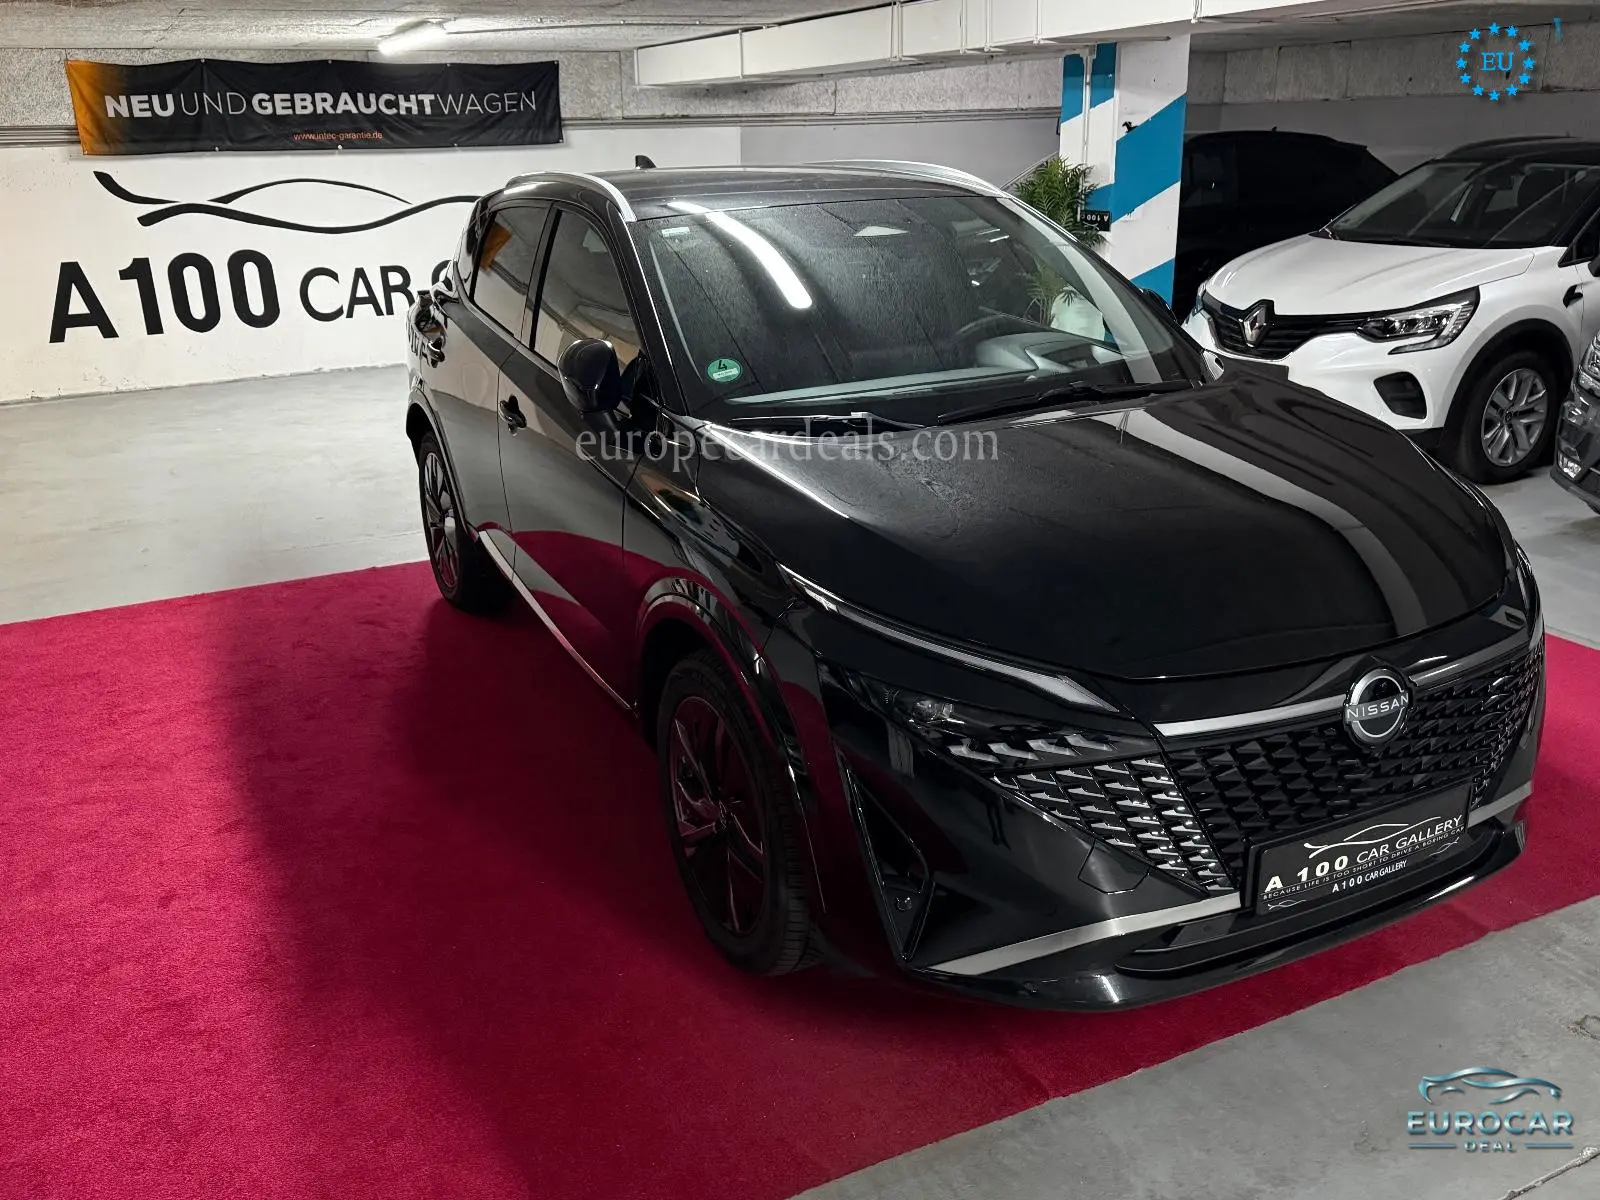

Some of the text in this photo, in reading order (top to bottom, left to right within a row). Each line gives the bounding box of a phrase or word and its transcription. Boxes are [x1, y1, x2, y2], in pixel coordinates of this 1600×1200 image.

[299, 265, 416, 322] CAR
[717, 359, 728, 370] 4
[1346, 692, 1409, 719] NISSAN
[1263, 884, 1301, 899] BECAUSE
[1304, 880, 1320, 889] LIFE
[1333, 870, 1350, 879] TOO
[1352, 860, 1377, 873] SHORT
[1391, 847, 1412, 859] DRIVE
[1422, 833, 1449, 847] BORING
[1264, 814, 1463, 893] A 100 CAR GALLERY
[1364, 870, 1379, 882] CAR
[1379, 859, 1408, 877] GALLERY
